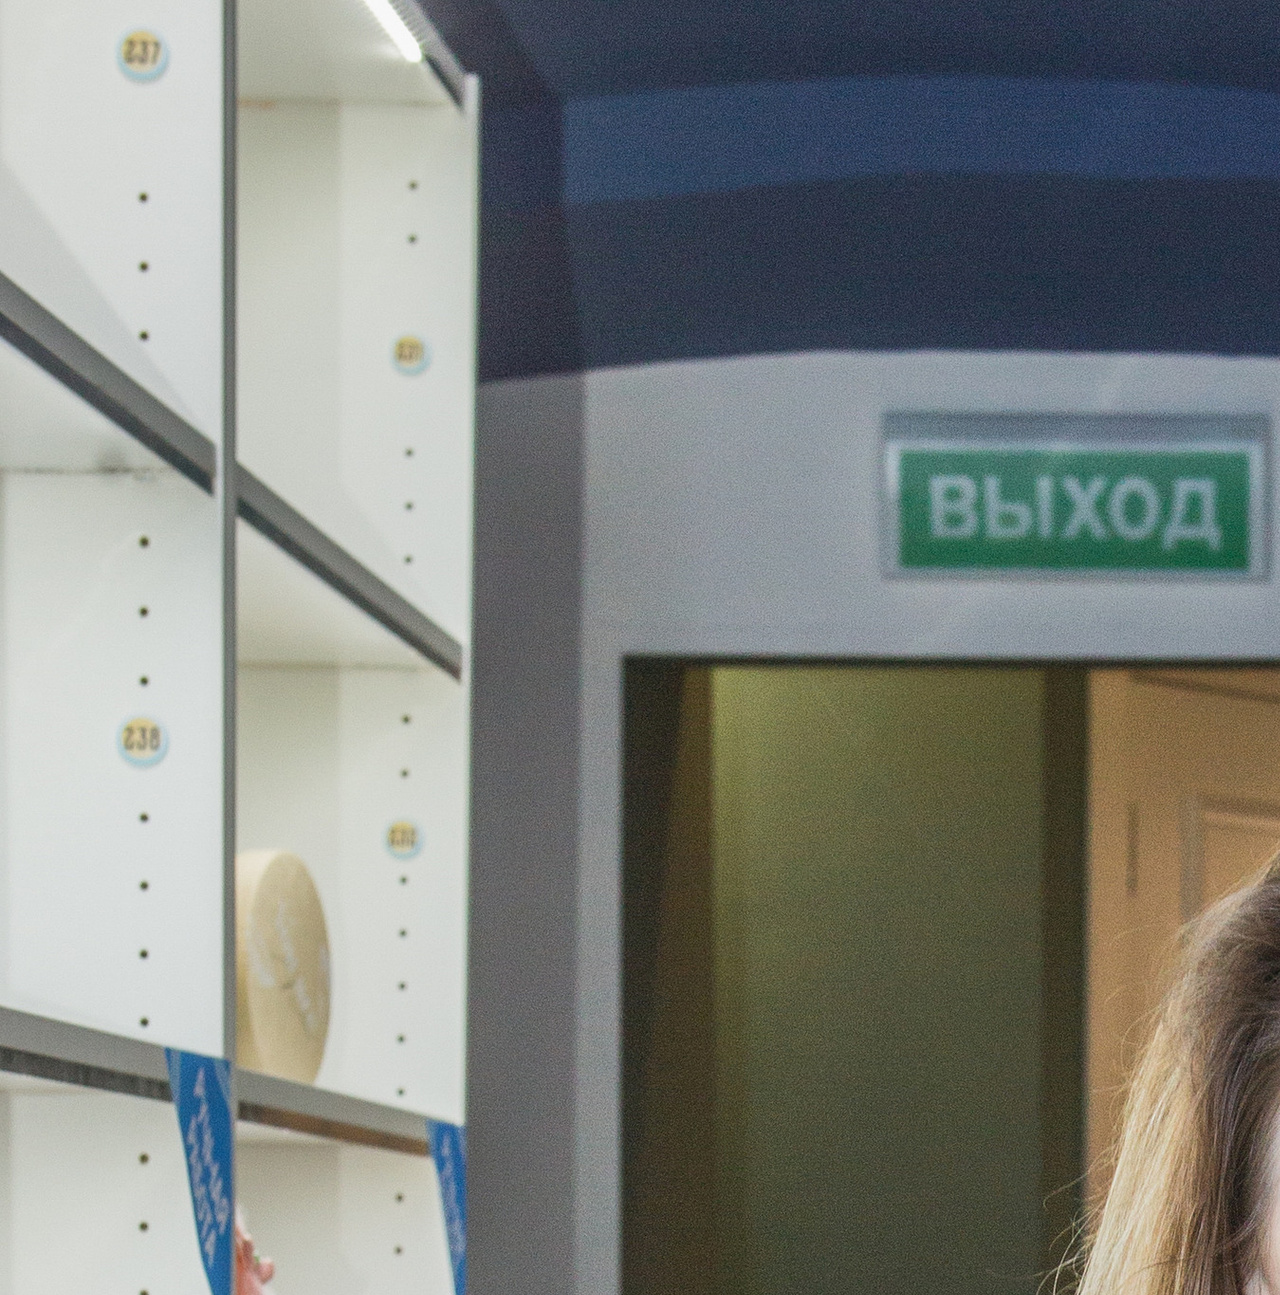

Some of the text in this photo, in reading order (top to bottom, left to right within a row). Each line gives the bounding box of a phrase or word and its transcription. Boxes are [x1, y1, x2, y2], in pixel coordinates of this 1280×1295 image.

[124, 38, 162, 65] 237
[928, 473, 1223, 552] ВЫХОД
[122, 725, 162, 752] 238
